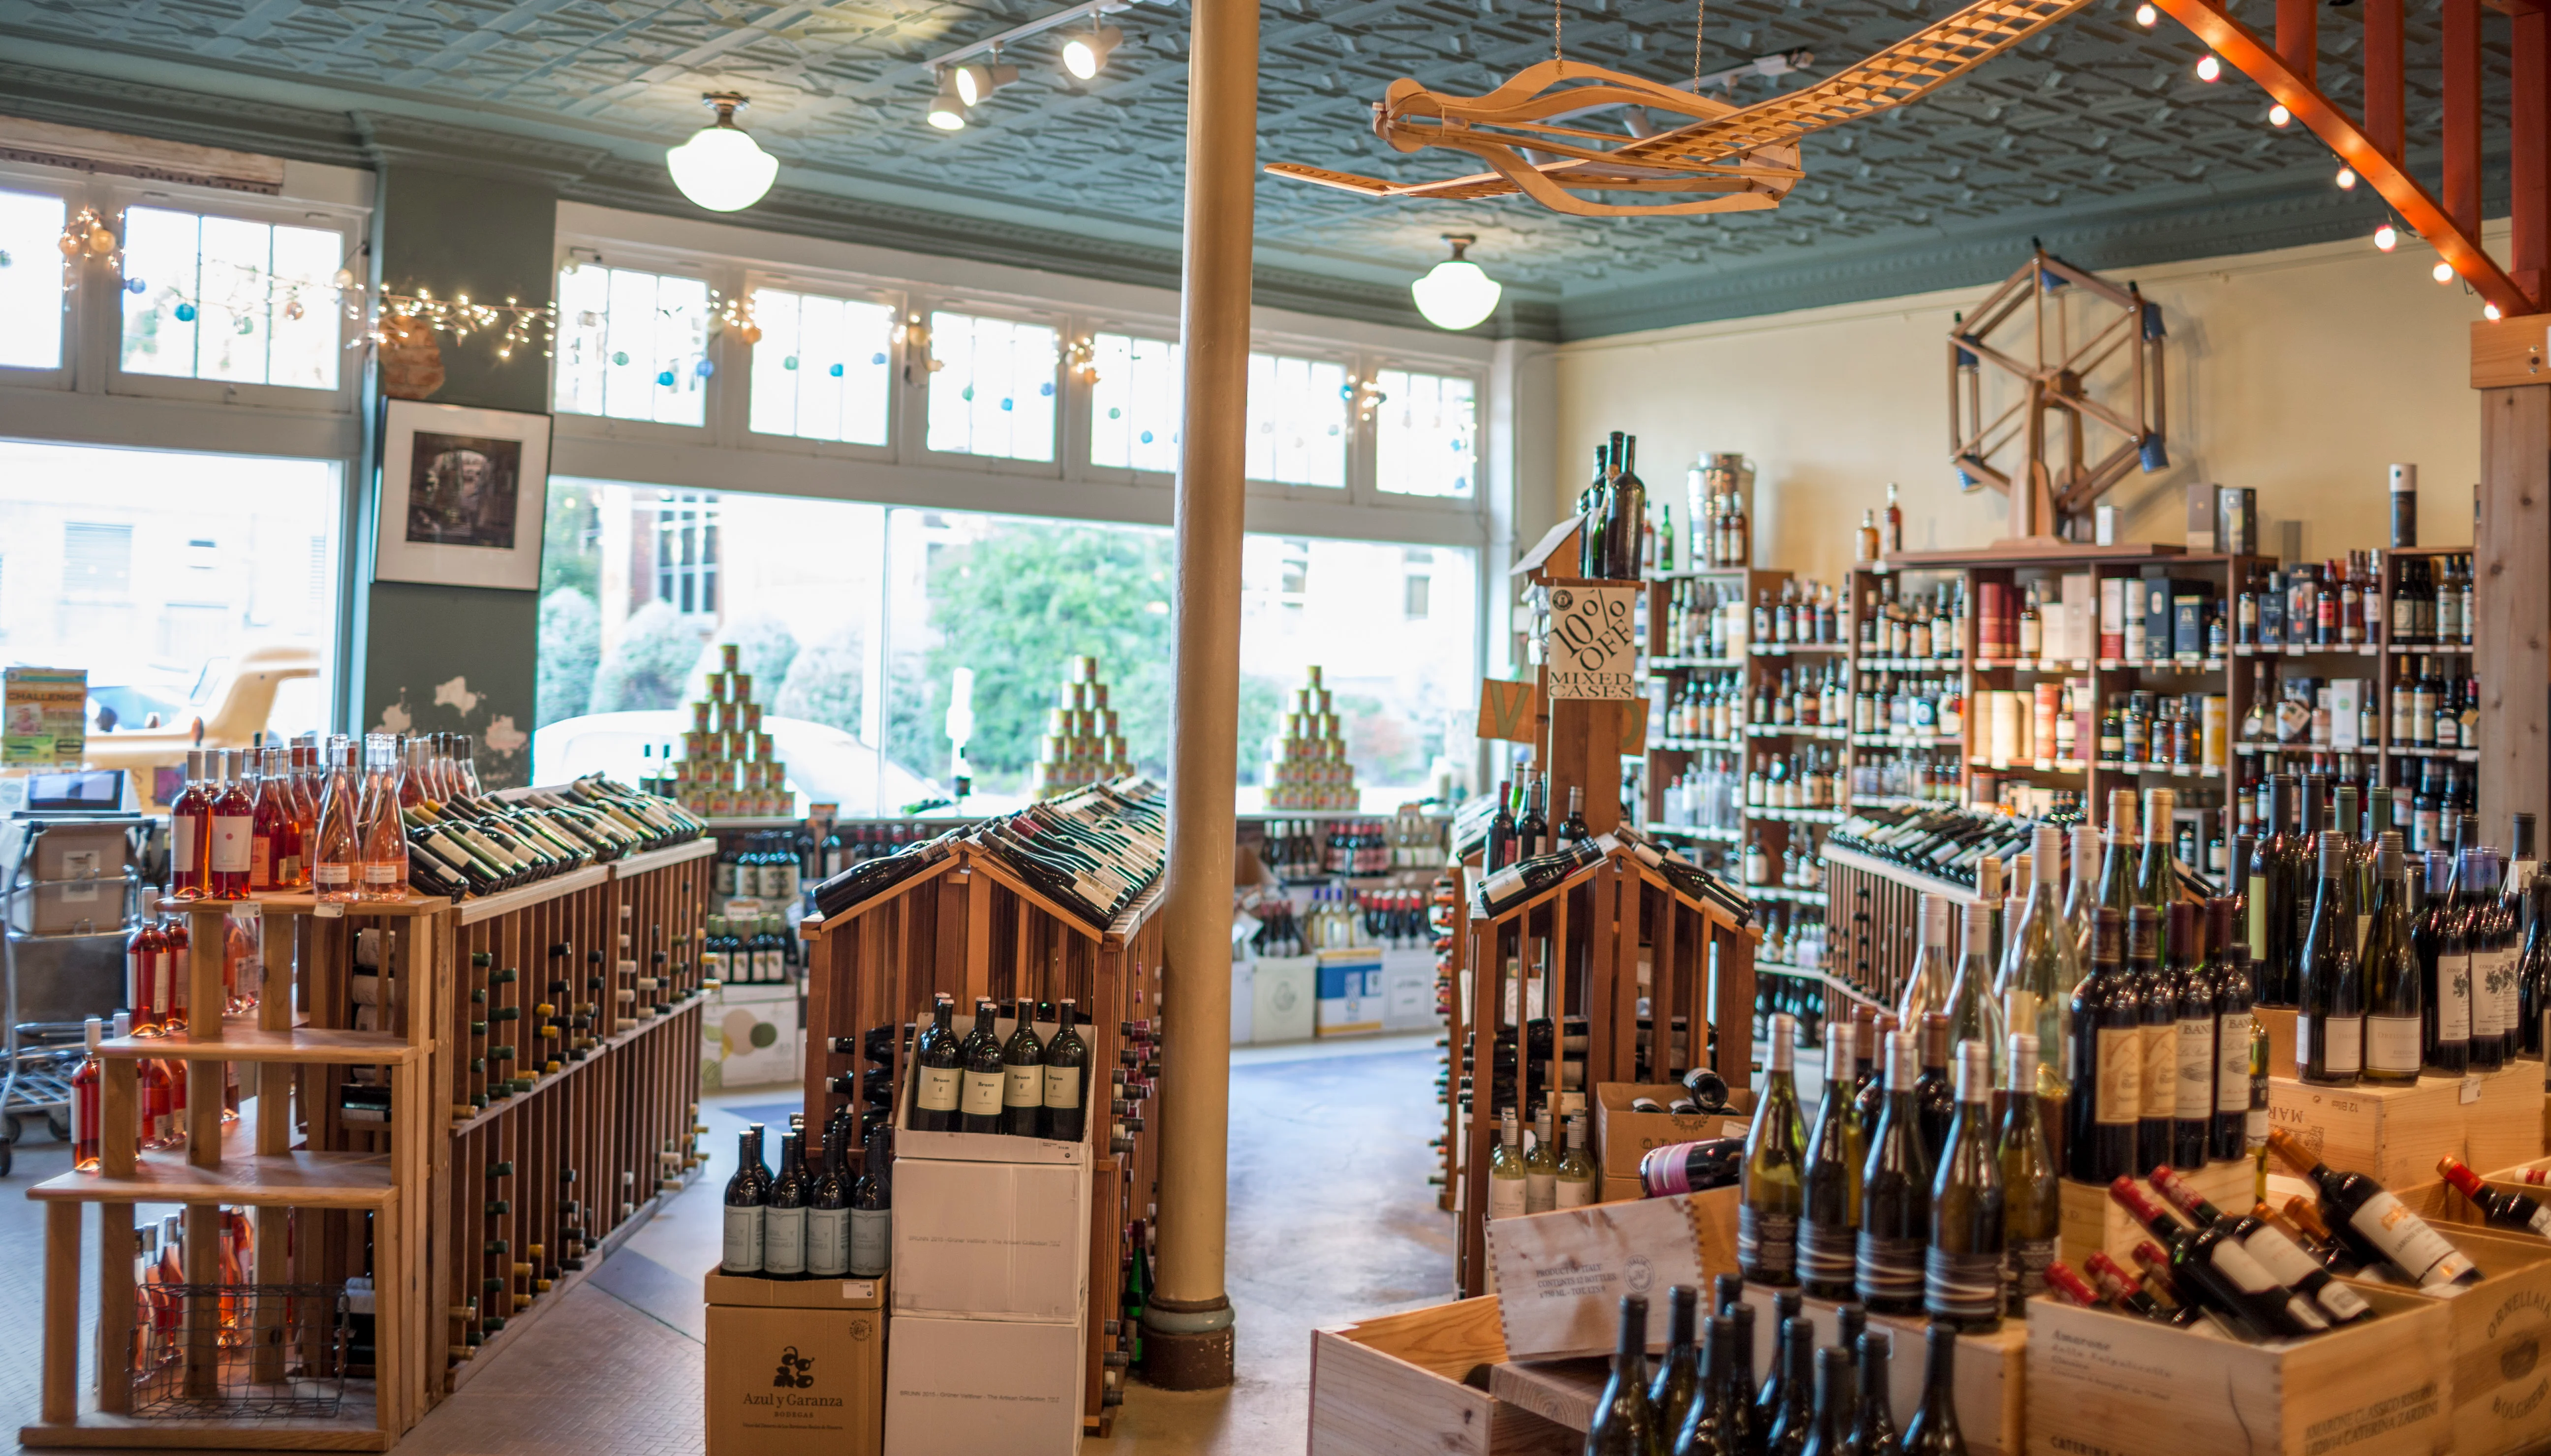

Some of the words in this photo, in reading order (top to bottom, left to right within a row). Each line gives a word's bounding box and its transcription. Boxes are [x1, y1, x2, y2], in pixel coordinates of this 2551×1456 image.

[1551, 589, 1626, 658] 10%
[1579, 619, 1632, 671] OFF
[1550, 672, 1632, 685] MIXED
[7, 693, 82, 702] CHALLENGE
[1549, 684, 1632, 698] CASES
[1536, 1267, 1569, 1278] PRODUCT
[1581, 1263, 1602, 1272] ITALY
[1538, 1278, 1575, 1288] CONTENTS
[1585, 1272, 1618, 1283] BOTTLES
[744, 1393, 774, 1405] Azul
[776, 1397, 785, 1408] y
[787, 1394, 843, 1407] Garanza
[2304, 1413, 2354, 1442] AMARONE
[2354, 1396, 2400, 1425] CLASSICO
[2344, 1417, 2396, 1446] CATERINA
[2397, 1400, 2439, 1427] ZARDINI
